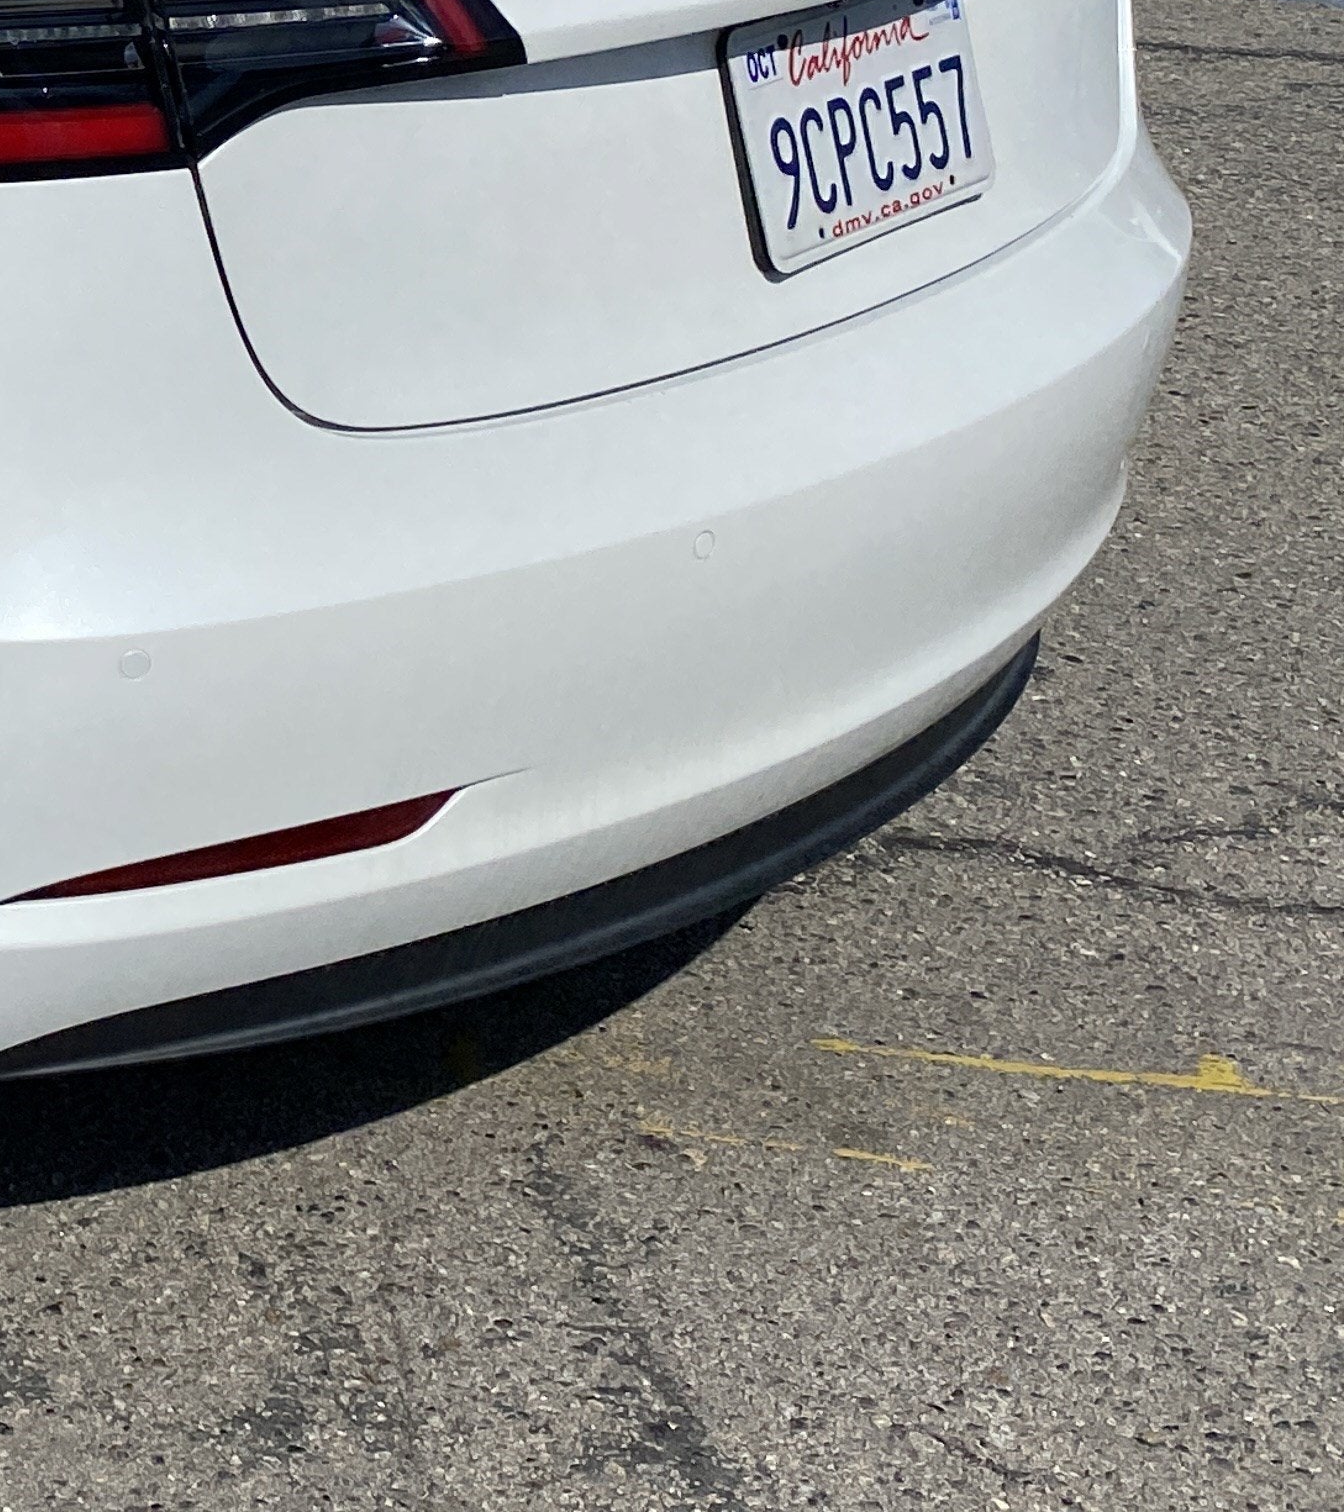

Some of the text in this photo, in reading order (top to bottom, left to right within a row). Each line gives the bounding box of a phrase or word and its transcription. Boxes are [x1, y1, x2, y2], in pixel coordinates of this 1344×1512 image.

[746, 44, 777, 83] OCT
[788, 15, 930, 87] California
[770, 54, 972, 230] 9CPC557
[832, 181, 944, 238] dmv.ca.gov
